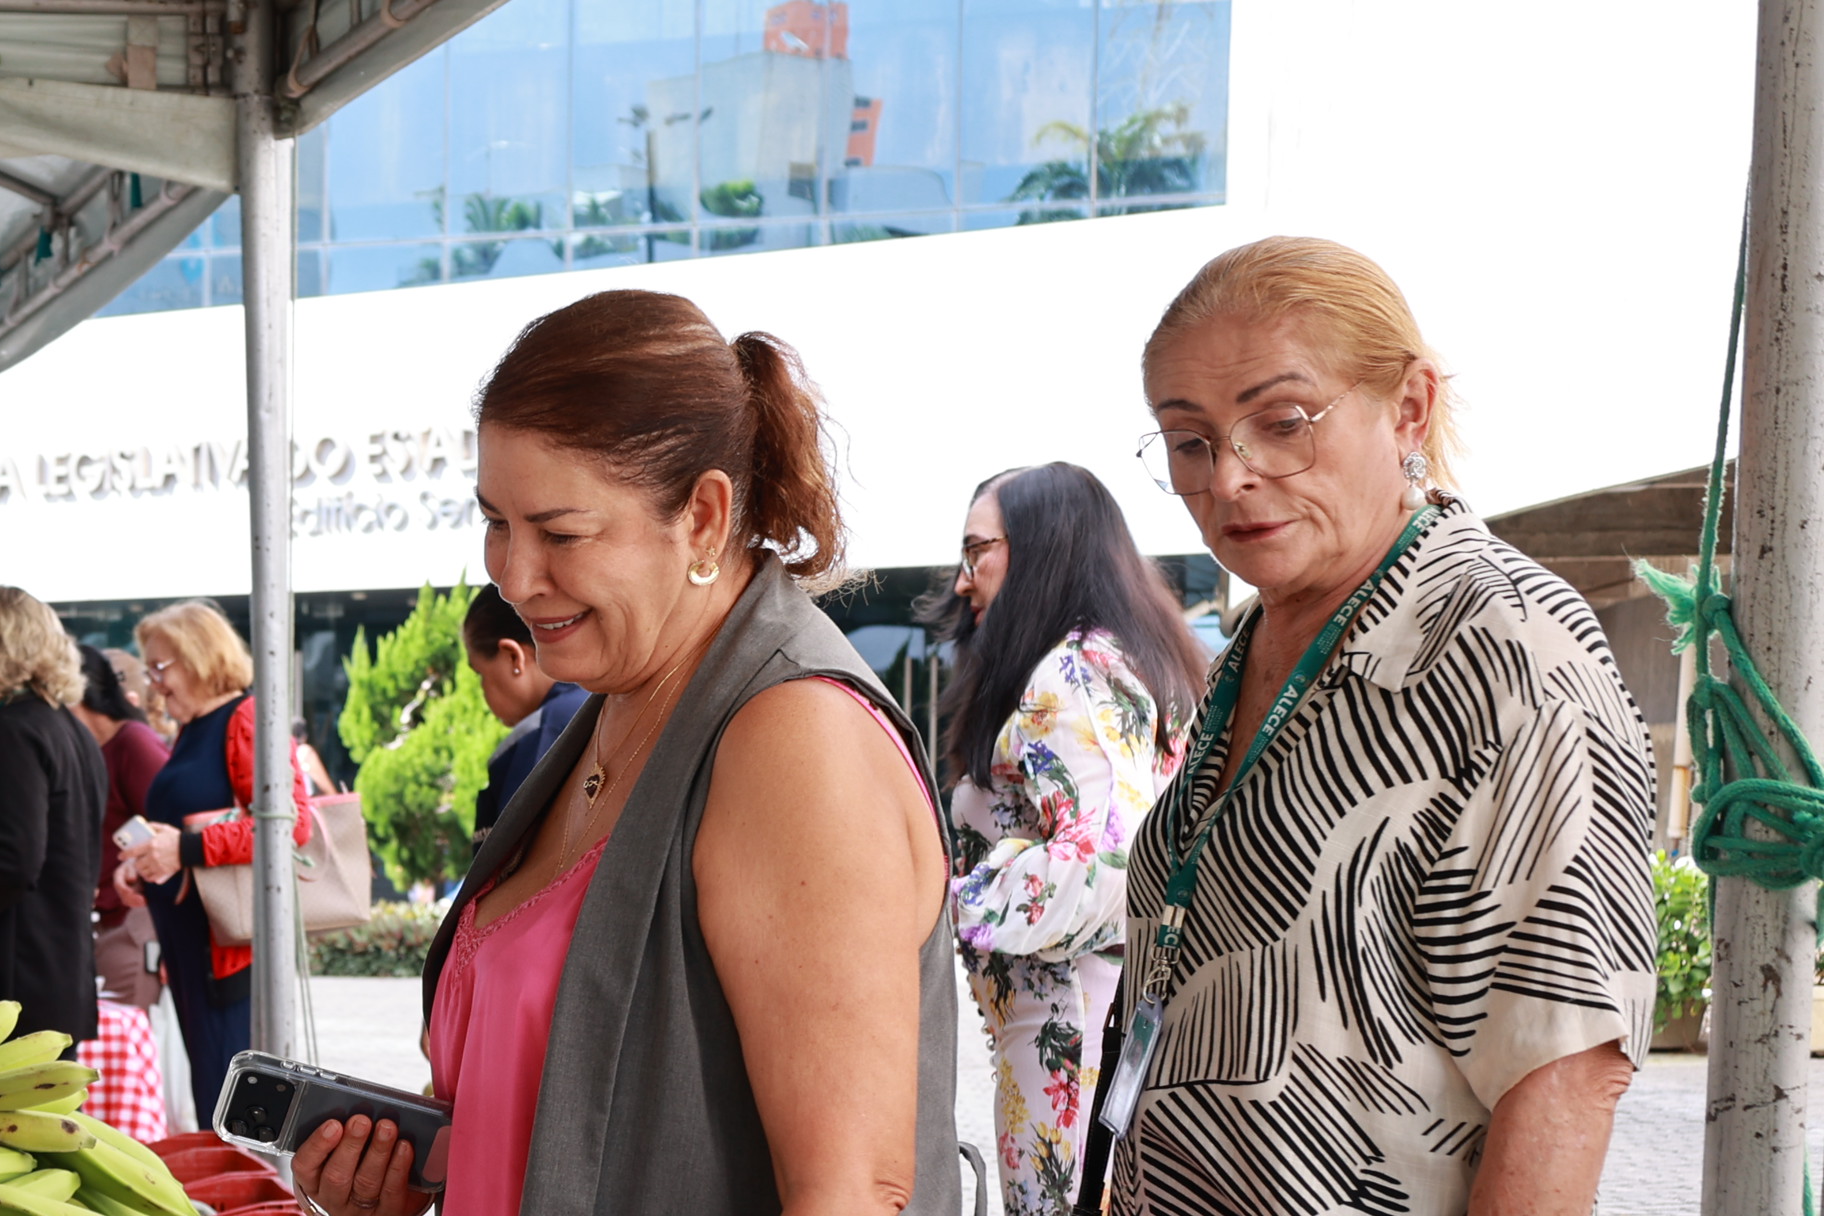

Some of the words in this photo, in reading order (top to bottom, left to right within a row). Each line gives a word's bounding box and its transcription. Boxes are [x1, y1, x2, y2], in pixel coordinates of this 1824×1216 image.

[1333, 579, 1377, 626] ALECE
[1227, 628, 1250, 673] ALECE
[1262, 684, 1299, 736] ALECE
